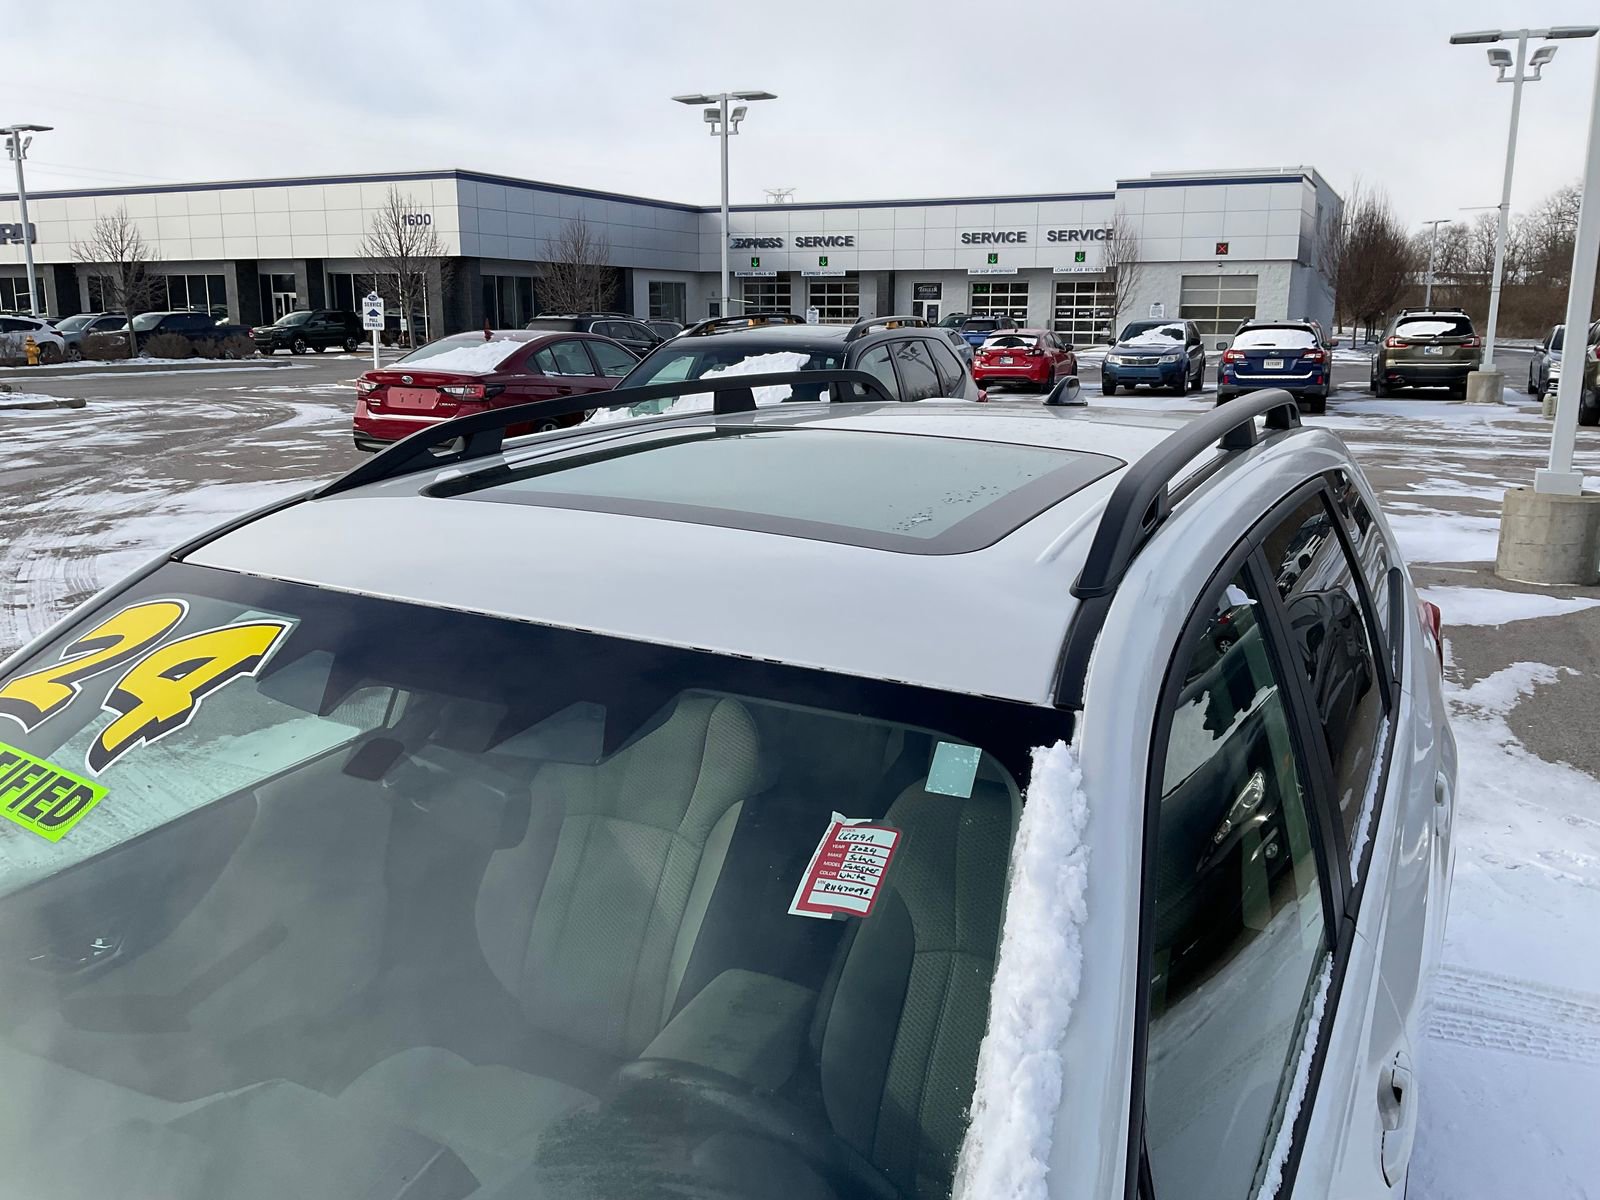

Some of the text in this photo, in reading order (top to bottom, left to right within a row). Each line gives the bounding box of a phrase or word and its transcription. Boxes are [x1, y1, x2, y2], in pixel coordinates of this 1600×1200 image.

[401, 213, 431, 226] 1600
[961, 231, 1027, 244] SERVICE
[1047, 228, 1114, 242] SERVICE
[730, 235, 855, 249] EXPRESS SERVICE
